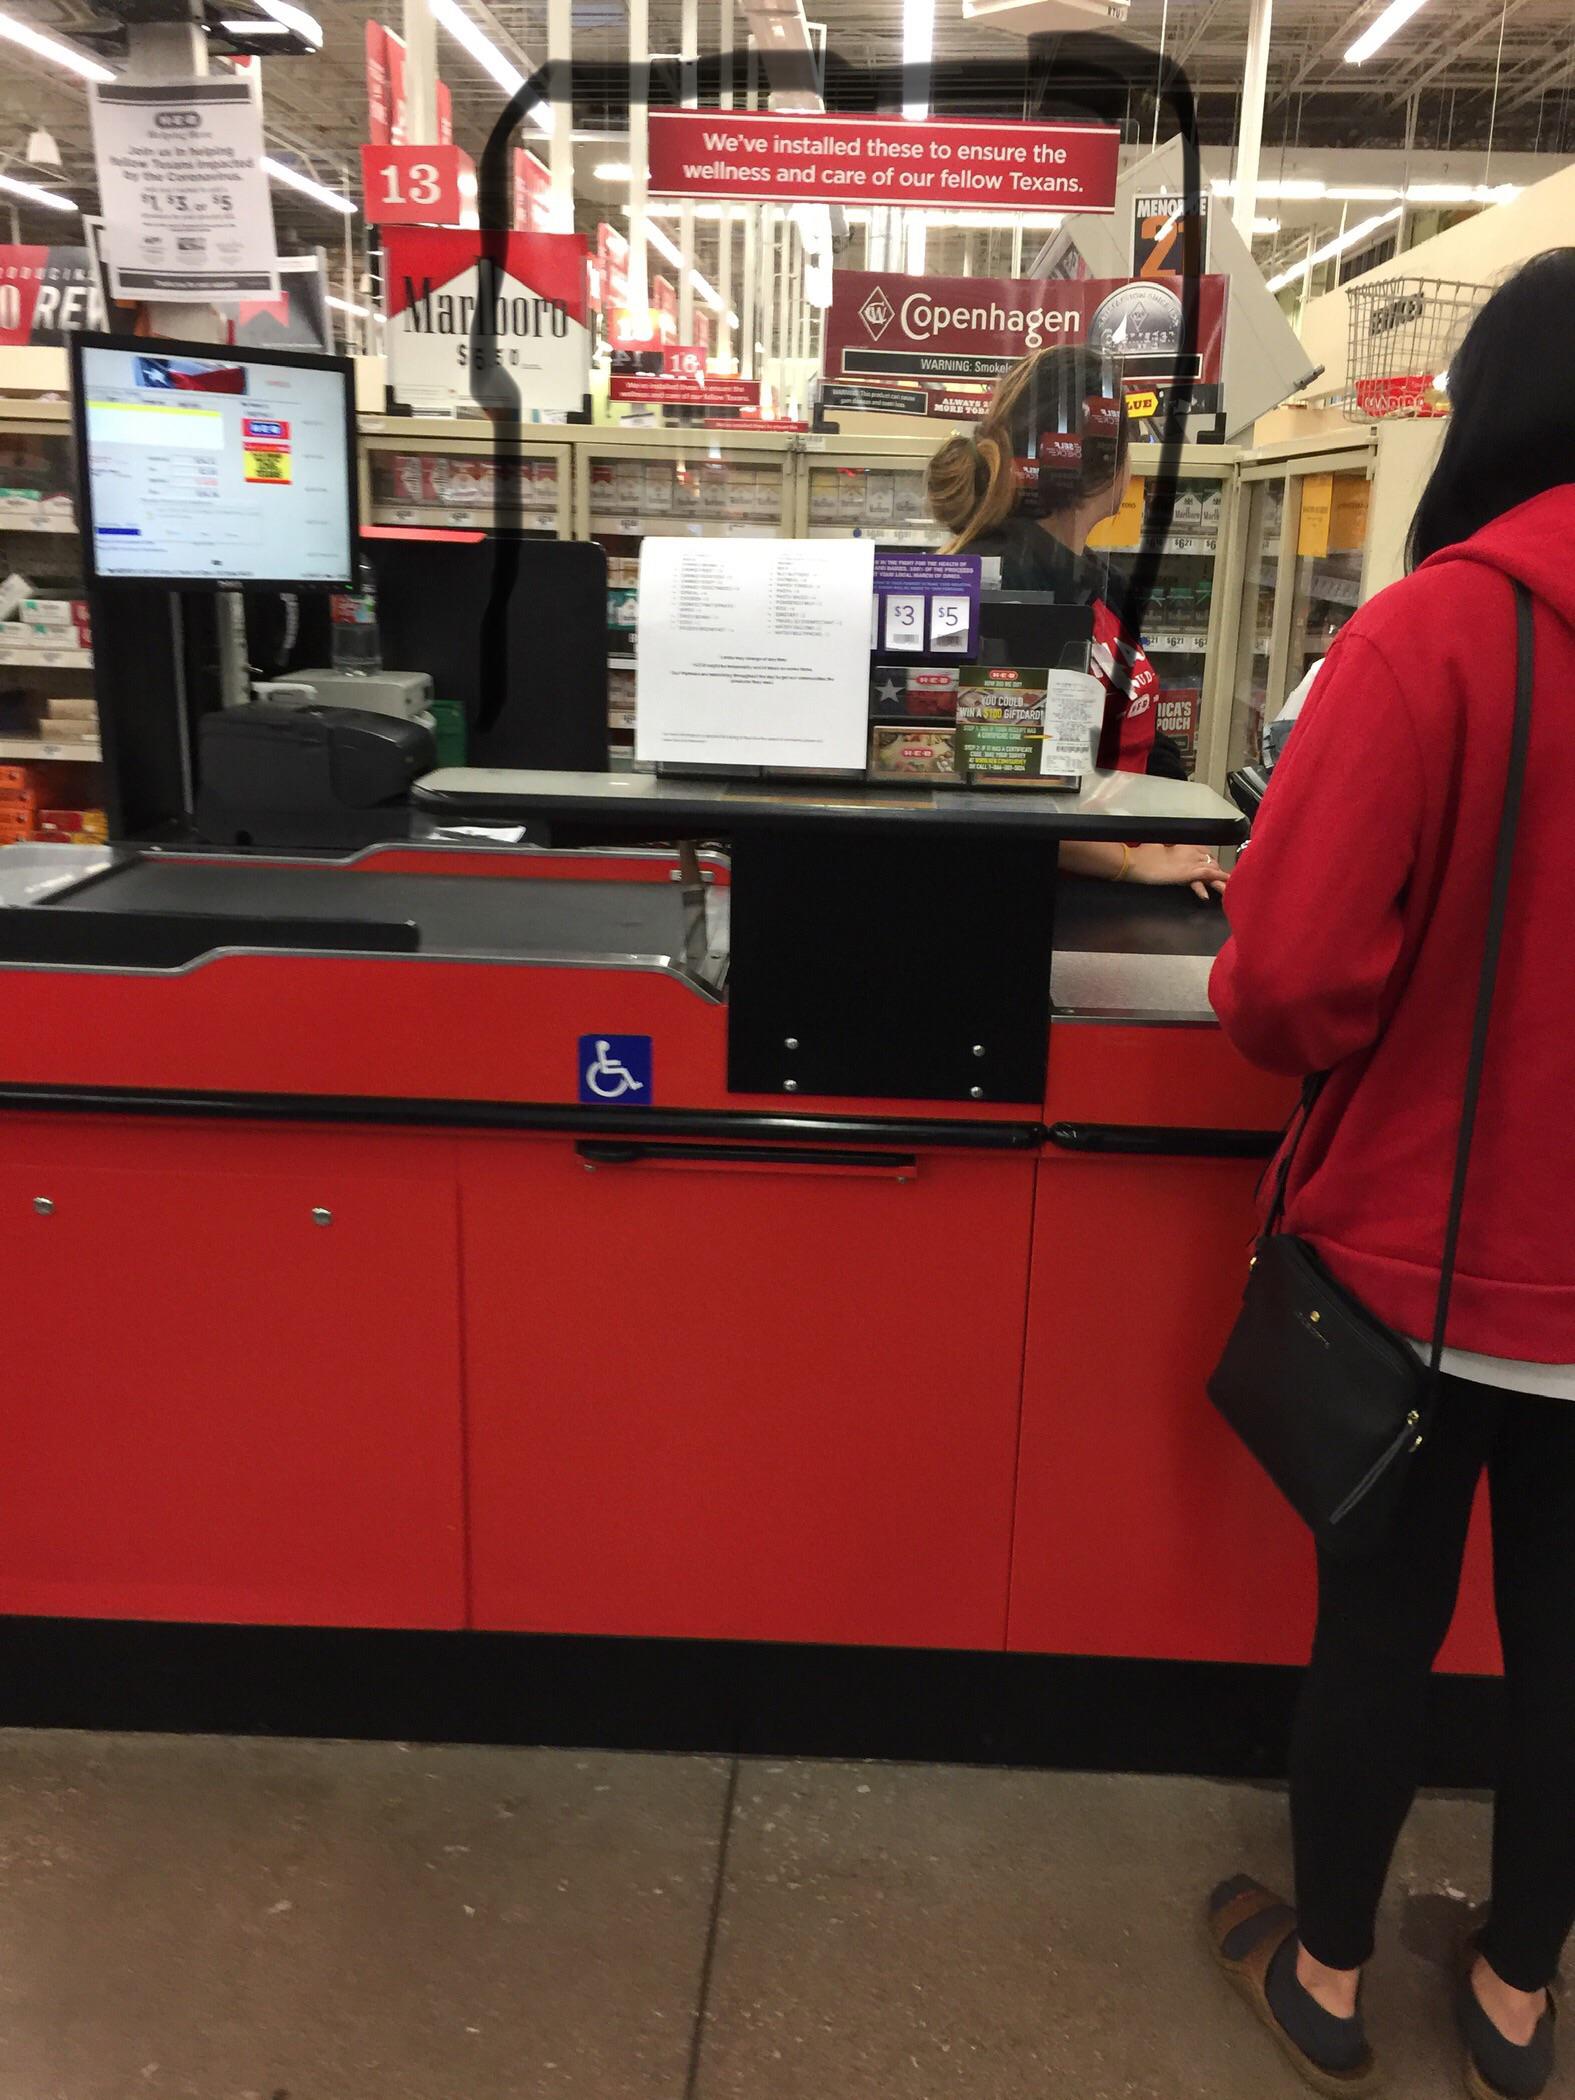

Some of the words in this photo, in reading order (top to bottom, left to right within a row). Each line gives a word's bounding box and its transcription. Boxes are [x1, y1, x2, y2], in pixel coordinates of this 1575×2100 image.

[703, 132, 768, 153] We've
[773, 135, 861, 156] installed
[867, 138, 924, 158] these
[929, 141, 951, 159] to
[957, 145, 1027, 162] ensure
[1033, 144, 1067, 164] the
[380, 163, 440, 204] 13
[683, 161, 771, 181] wellness
[776, 165, 815, 183] and
[821, 169, 866, 185] care
[872, 167, 895, 186] of
[900, 171, 935, 187] our
[940, 169, 1003, 189] fellow
[1009, 171, 1084, 192] Texans.
[403, 257, 568, 338] Marlboro
[901, 293, 1080, 348] Copenhagen
[920, 358, 973, 372] WARNING:
[934, 404, 964, 414] MORE
[942, 398, 981, 408] ALWAYS
[894, 605, 915, 626] $3
[938, 606, 958, 627] $5
[998, 696, 1023, 707] COULD
[960, 708, 974, 718] WIN
[976, 708, 982, 718] A
[1156, 717, 1191, 731] POUCH
